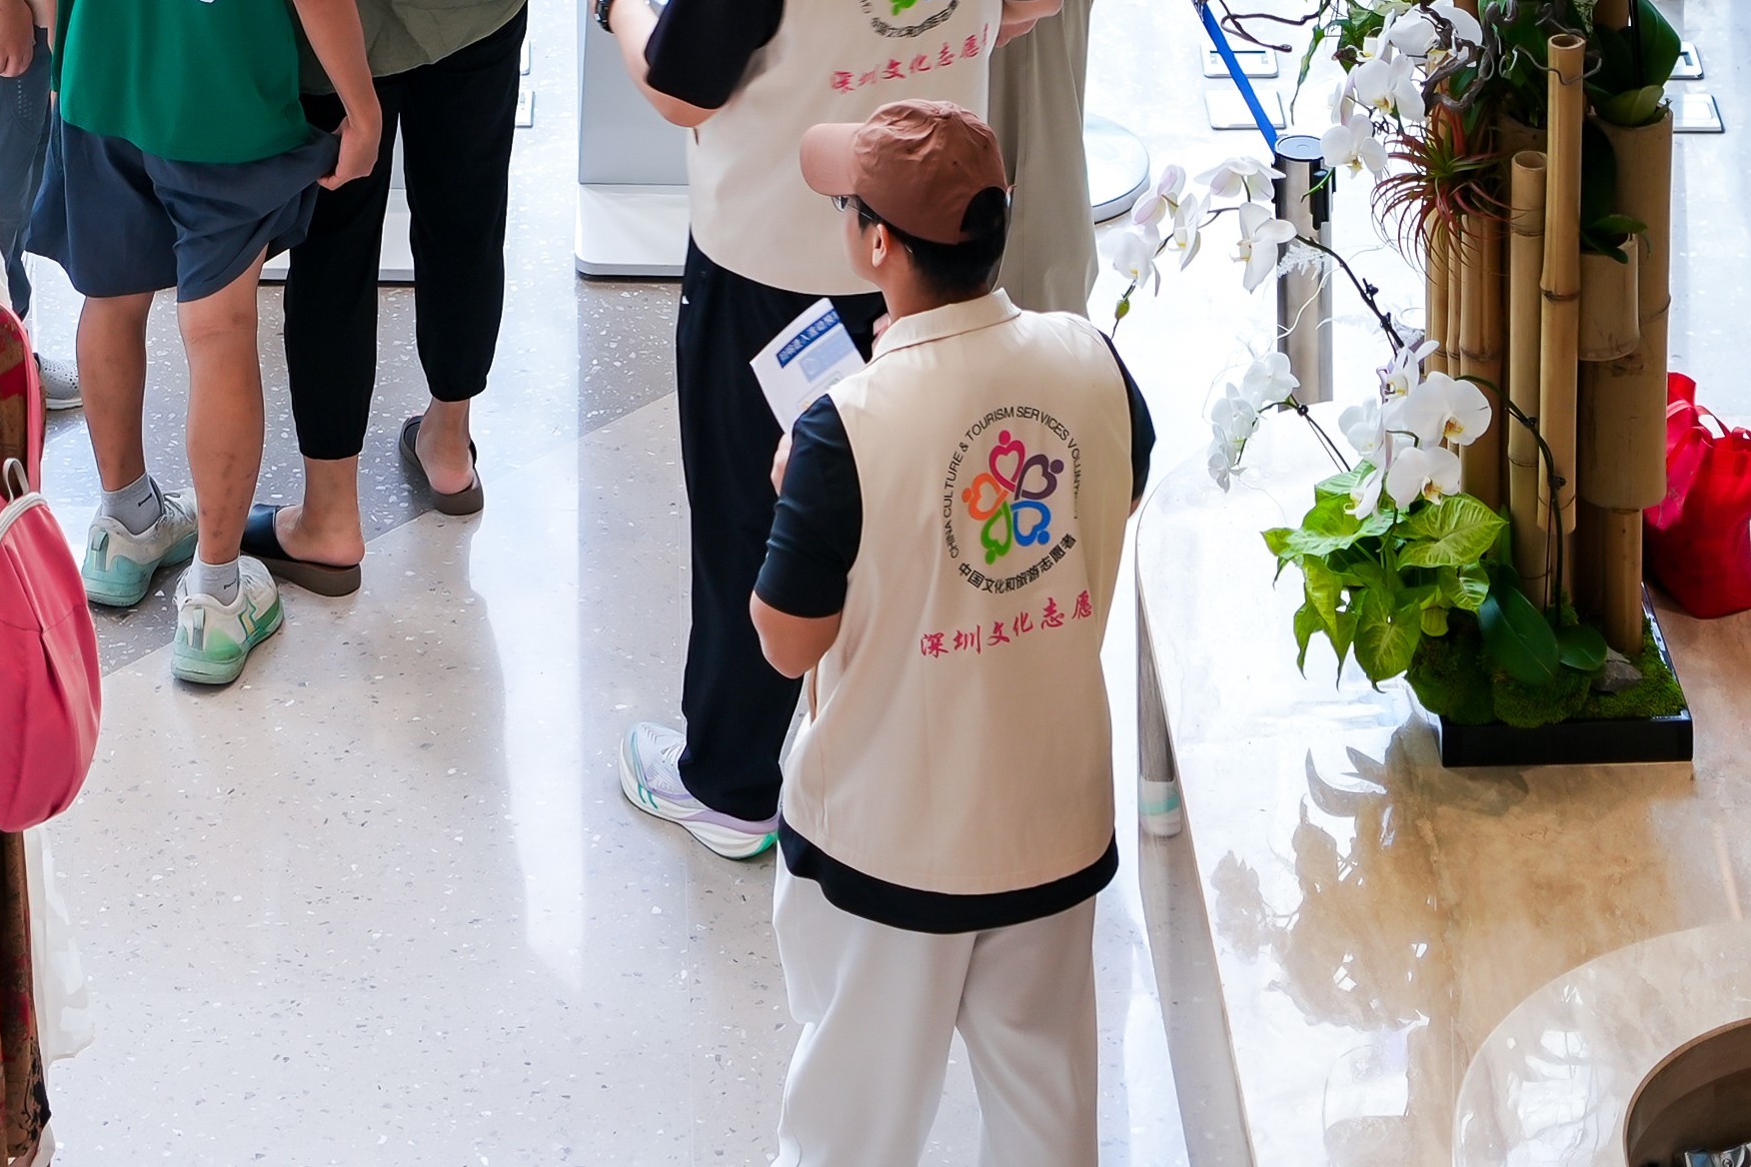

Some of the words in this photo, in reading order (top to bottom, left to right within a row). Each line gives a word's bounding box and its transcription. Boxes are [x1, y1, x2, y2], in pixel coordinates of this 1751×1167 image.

[829, 22, 990, 94] 深圳文化志愿
[965, 406, 1015, 441] TOURISM
[1016, 406, 1070, 441] SERVICES
[943, 451, 964, 518] CULTURE
[944, 520, 959, 559] CHINA
[958, 533, 1077, 594] 中国文化和旅游志愿者
